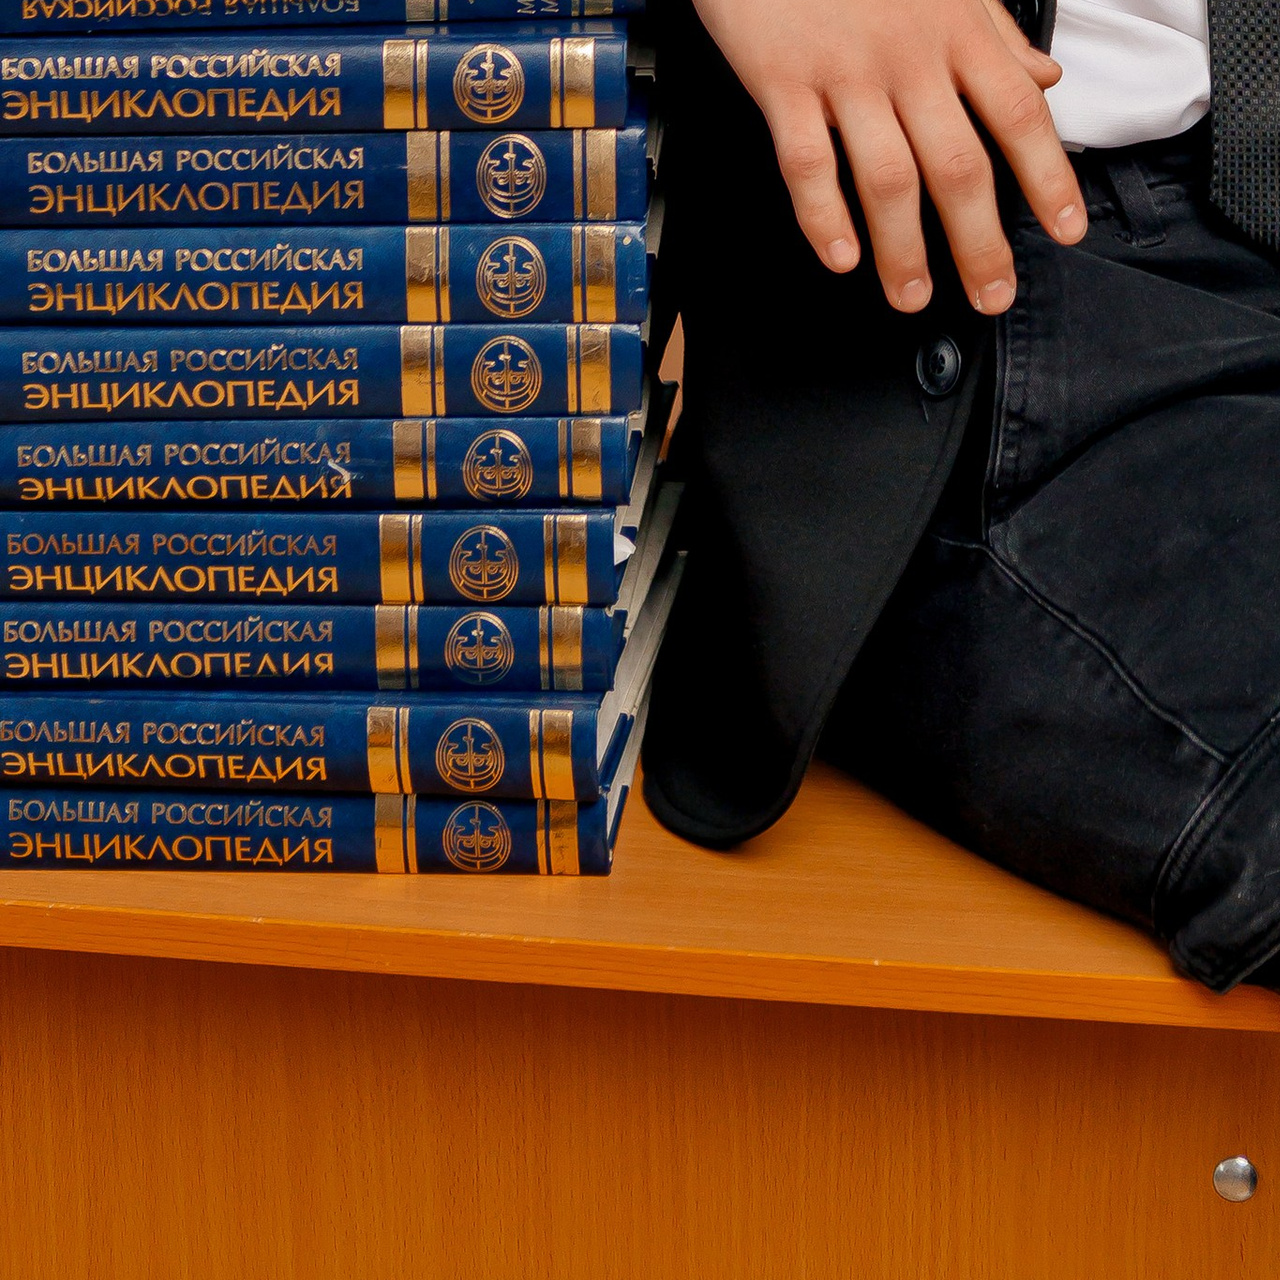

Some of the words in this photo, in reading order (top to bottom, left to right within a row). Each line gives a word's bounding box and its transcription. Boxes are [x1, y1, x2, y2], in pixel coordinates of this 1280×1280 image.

[1, 54, 139, 81] БОЛЬШАЯ
[151, 48, 342, 79] РОССИЙСКАЯ
[1, 87, 342, 123] ЭНЦИКЛОПЕДИЯ
[27, 149, 164, 174] БОЛЬШАЯ
[175, 143, 365, 172] РОССИЙСКАЯ
[28, 179, 365, 217] ЭНЦИКЛОПЕДИЯ
[27, 248, 164, 273] БОЛЬШАЯ
[175, 242, 364, 272] РОССИЙСКАЯ
[28, 281, 365, 316] ЭНЦИКЛОПЕДИЯ
[21, 349, 158, 375] БОЛЬШАЯ
[170, 342, 359, 373] РОССИЙСКАЯ
[22, 378, 360, 412] ЭНЦИКЛОПЕДИЯ
[17, 443, 152, 468] БОЛЬШАЯ
[164, 437, 351, 467] РОССИЙСКАЯ
[18, 473, 353, 502] ЭНЦИКЛОПЕДИЯ
[7, 533, 140, 555] БОЛЬШАЯ
[152, 528, 337, 556] РОССИЙСКАЯ
[7, 564, 339, 597] ЭНЦИКЛОПЕДИЯ
[3, 620, 137, 643] БОЛЬШАЯ
[149, 615, 333, 643] РОССИЙСКАЯ
[0, 720, 131, 743] БОЛЬШАЯ
[143, 718, 326, 747] РОССИЙСКАЯ
[1, 751, 327, 783] ЭНЦИКЛОПЕДИЯ
[8, 799, 139, 823] БОЛЬШАЯ
[151, 795, 333, 828] РОССИЙСКАЯ
[9, 833, 334, 866] ЭНЦИКЛОПЕДИЯ
